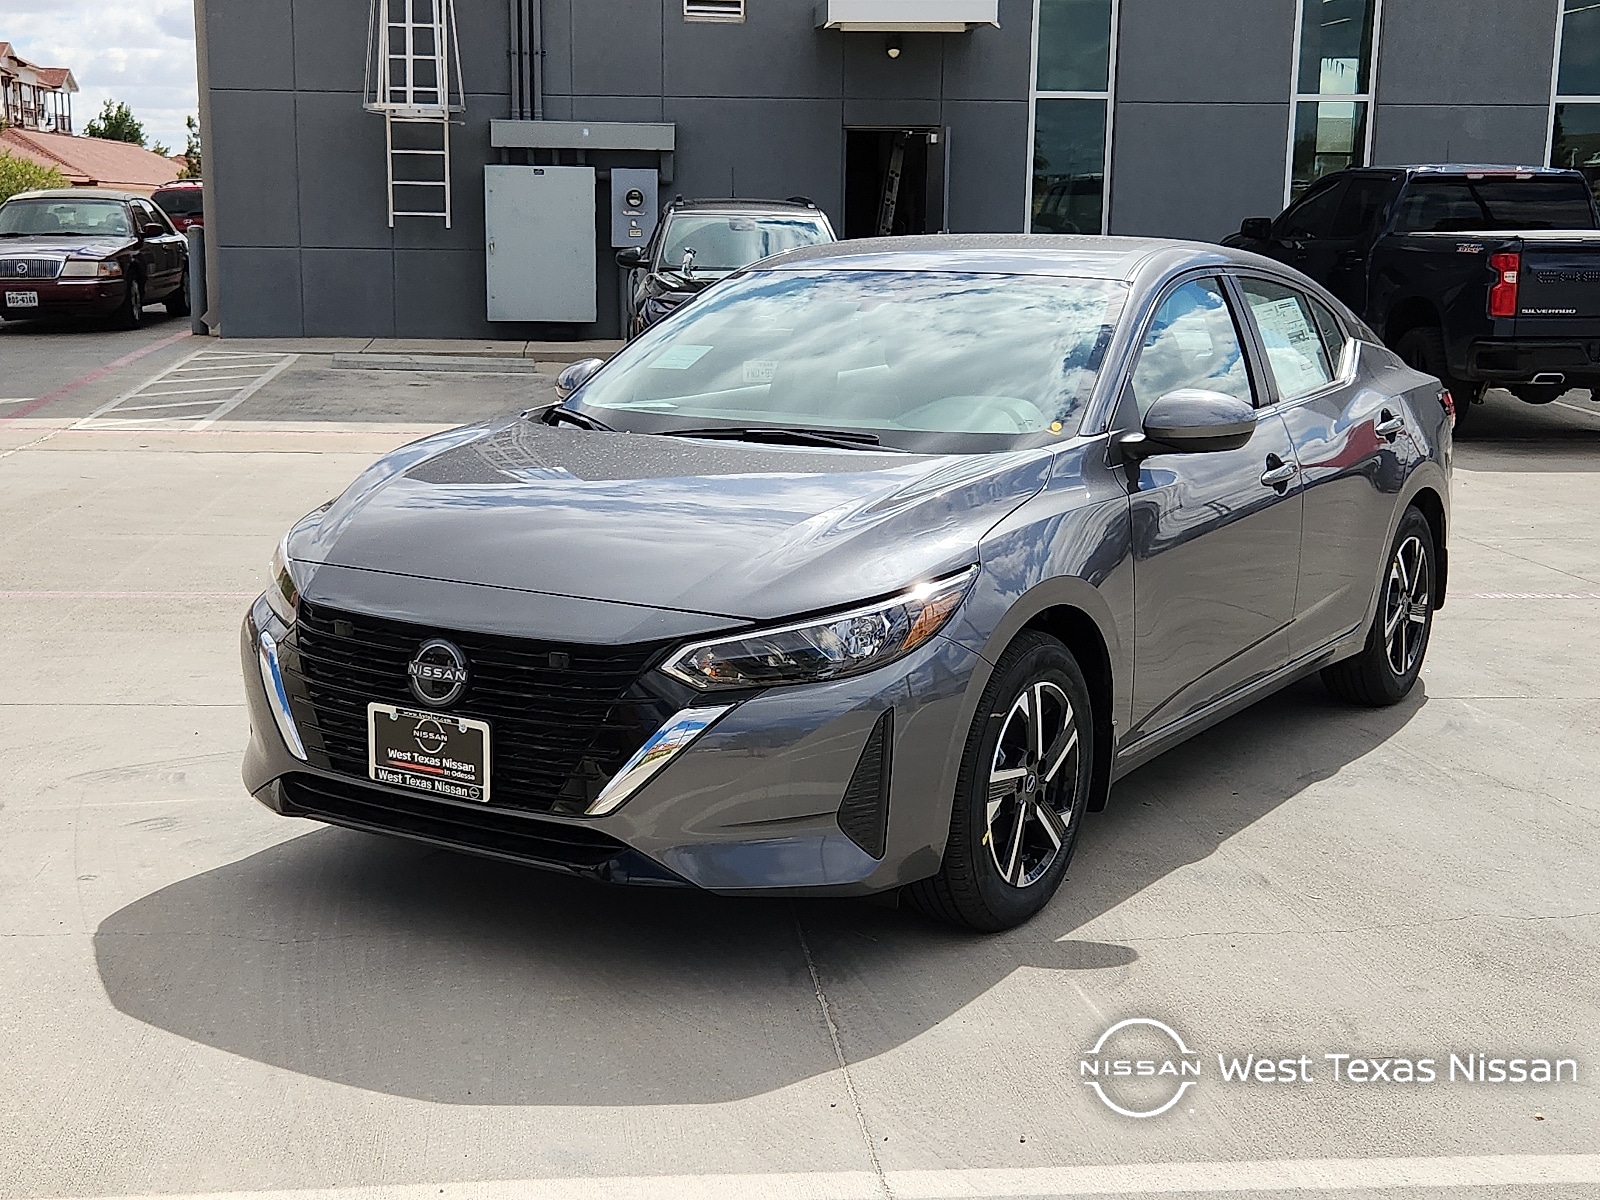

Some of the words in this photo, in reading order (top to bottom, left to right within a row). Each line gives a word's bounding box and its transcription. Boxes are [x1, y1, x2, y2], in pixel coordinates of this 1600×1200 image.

[408, 662, 467, 681] NISSAN
[413, 729, 448, 742] NISSAN
[387, 748, 412, 761] West
[413, 753, 441, 767] Texas
[442, 758, 475, 773] Nissan
[378, 769, 403, 784] West
[404, 775, 432, 790] Texas
[434, 782, 468, 797] Nissan
[451, 771, 476, 781] Odessa
